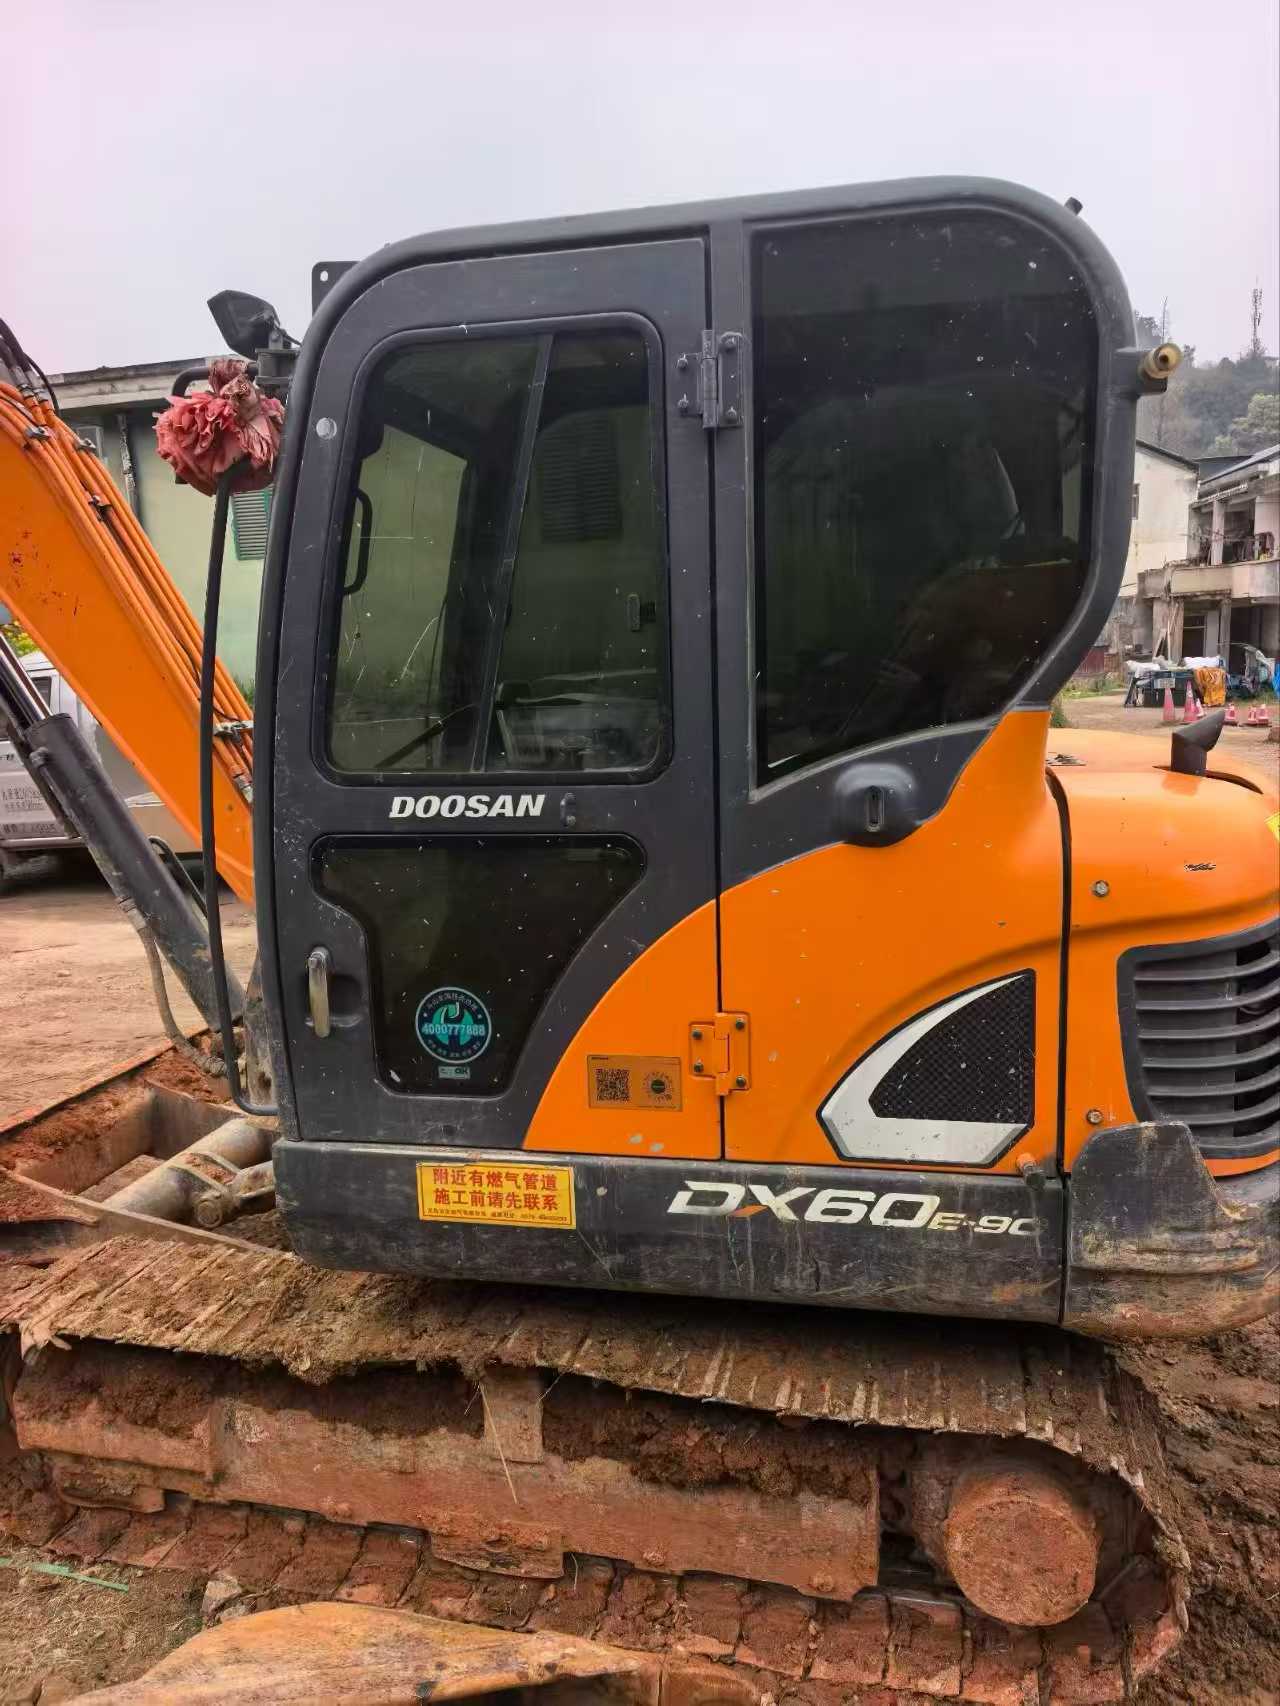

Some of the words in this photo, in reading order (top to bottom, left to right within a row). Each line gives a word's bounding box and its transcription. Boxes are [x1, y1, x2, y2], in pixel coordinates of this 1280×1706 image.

[389, 794, 546, 818] DOOSAN
[432, 1167, 558, 1191] 附近有燃气管道
[434, 1187, 559, 1212] 施工前请先联系
